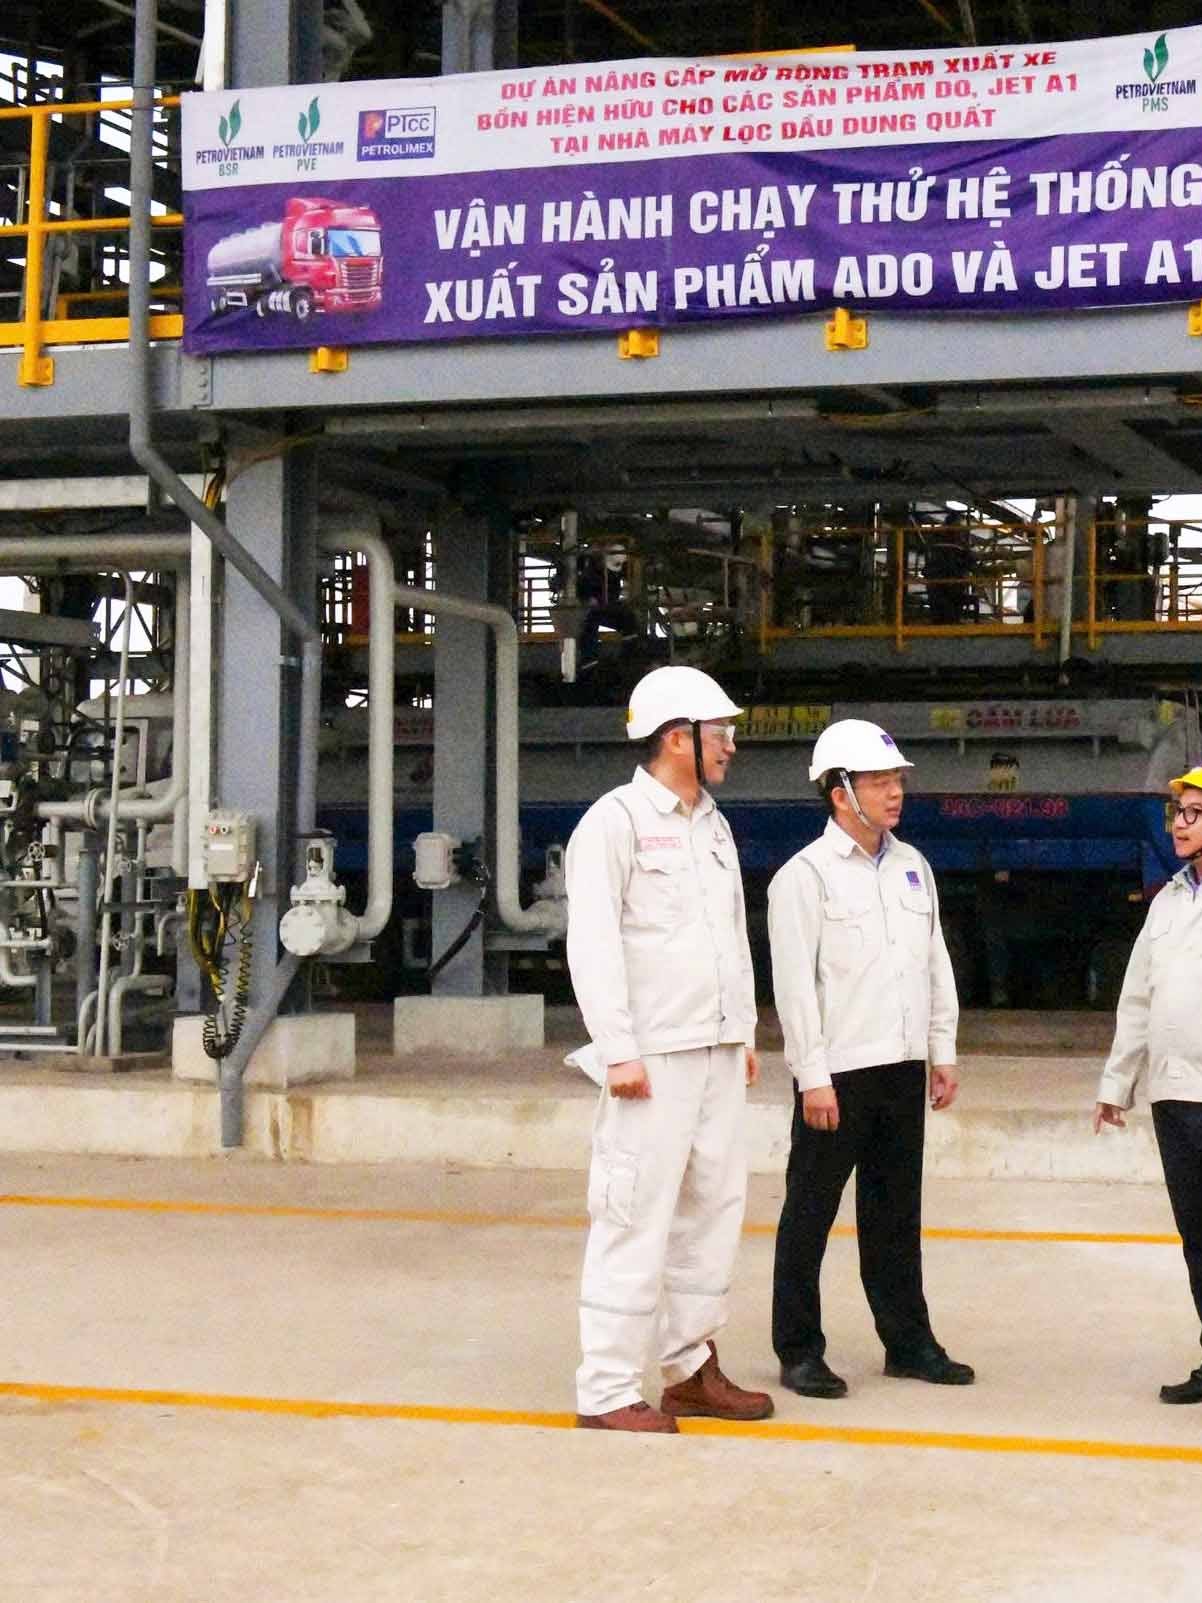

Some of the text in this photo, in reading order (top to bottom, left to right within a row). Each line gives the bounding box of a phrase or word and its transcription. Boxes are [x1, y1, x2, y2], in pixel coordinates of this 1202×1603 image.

[501, 80, 535, 101] DỰ
[542, 75, 577, 97] ÁN
[585, 70, 656, 93] NÂNG
[664, 64, 715, 87] CẤP
[1023, 51, 1057, 67] XE
[1115, 79, 1196, 99] PETROVIETNAM
[536, 104, 594, 127] HIỆN
[603, 98, 653, 122] HỮU
[662, 97, 713, 116] CHO
[722, 90, 773, 113] CÁC
[782, 84, 836, 108] SẢN
[935, 79, 977, 98] DO,
[988, 76, 1036, 95] JET
[1046, 73, 1079, 92] A1
[1142, 97, 1168, 112] PMS
[550, 135, 588, 157] TẠI
[598, 127, 650, 151] NHÀ
[658, 122, 715, 146] MÁY
[722, 123, 772, 144] LỌC
[842, 113, 916, 135] DUNG
[927, 103, 996, 132] QUẤT
[196, 145, 264, 165] PETROVIETNAM
[272, 141, 344, 158] PETROVIETNAM
[361, 142, 433, 156] PETROLIMEX
[218, 162, 239, 176] BSR
[297, 158, 317, 171] PVE
[434, 198, 526, 257] VẬN
[542, 190, 673, 243] HÀNH
[689, 184, 816, 239] CHẠY
[833, 166, 936, 225] THỬ
[946, 166, 1011, 228] HỆ
[424, 261, 542, 323] XUẤT
[558, 257, 657, 316] SẢN
[674, 244, 816, 310] PHẨM
[832, 252, 933, 298] ADO
[952, 240, 1018, 293] VÀ
[1034, 242, 1128, 290] JET
